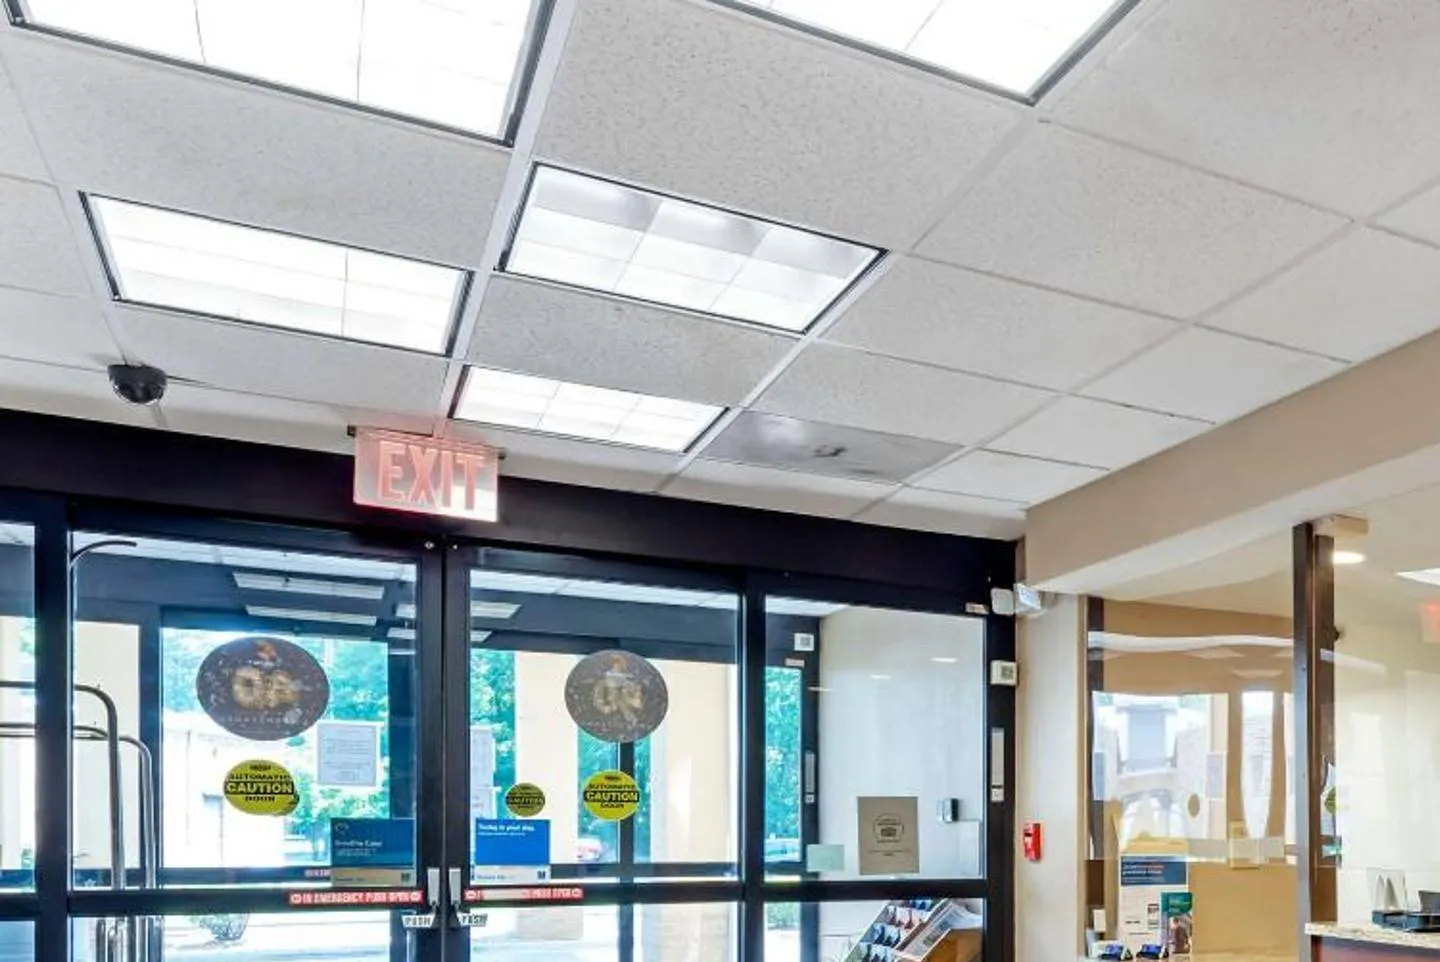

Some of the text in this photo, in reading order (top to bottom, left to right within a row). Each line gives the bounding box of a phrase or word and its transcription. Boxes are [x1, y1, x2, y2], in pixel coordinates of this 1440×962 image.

[379, 440, 486, 511] EXIT
[227, 782, 293, 793] CAUTION
[586, 791, 638, 801] CAUTION
[404, 916, 432, 927] PUSH
